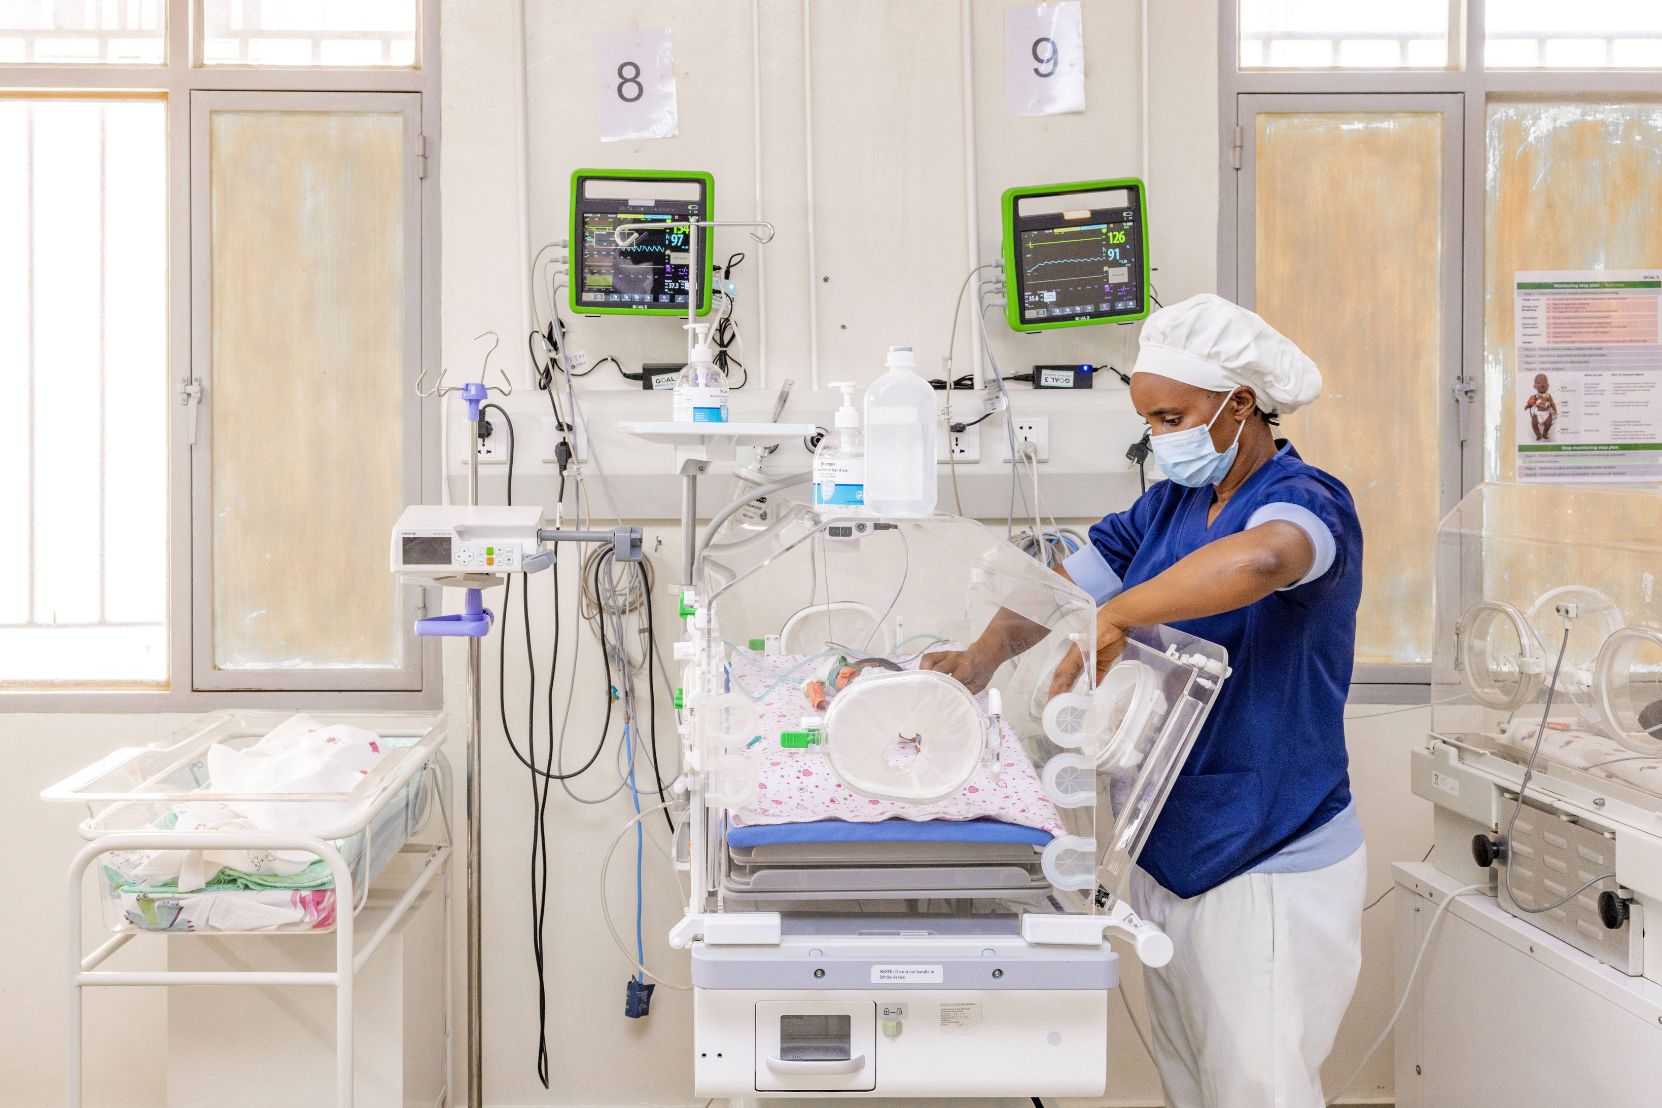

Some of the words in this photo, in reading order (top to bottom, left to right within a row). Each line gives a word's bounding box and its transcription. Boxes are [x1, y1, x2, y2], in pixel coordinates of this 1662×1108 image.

[1032, 37, 1058, 78] 9
[617, 61, 643, 102] 8
[671, 234, 684, 246] 97
[1108, 231, 1125, 243] 126
[1108, 248, 1119, 260] 91
[655, 376, 676, 384] GOAL
[1051, 376, 1071, 384] GOAL
